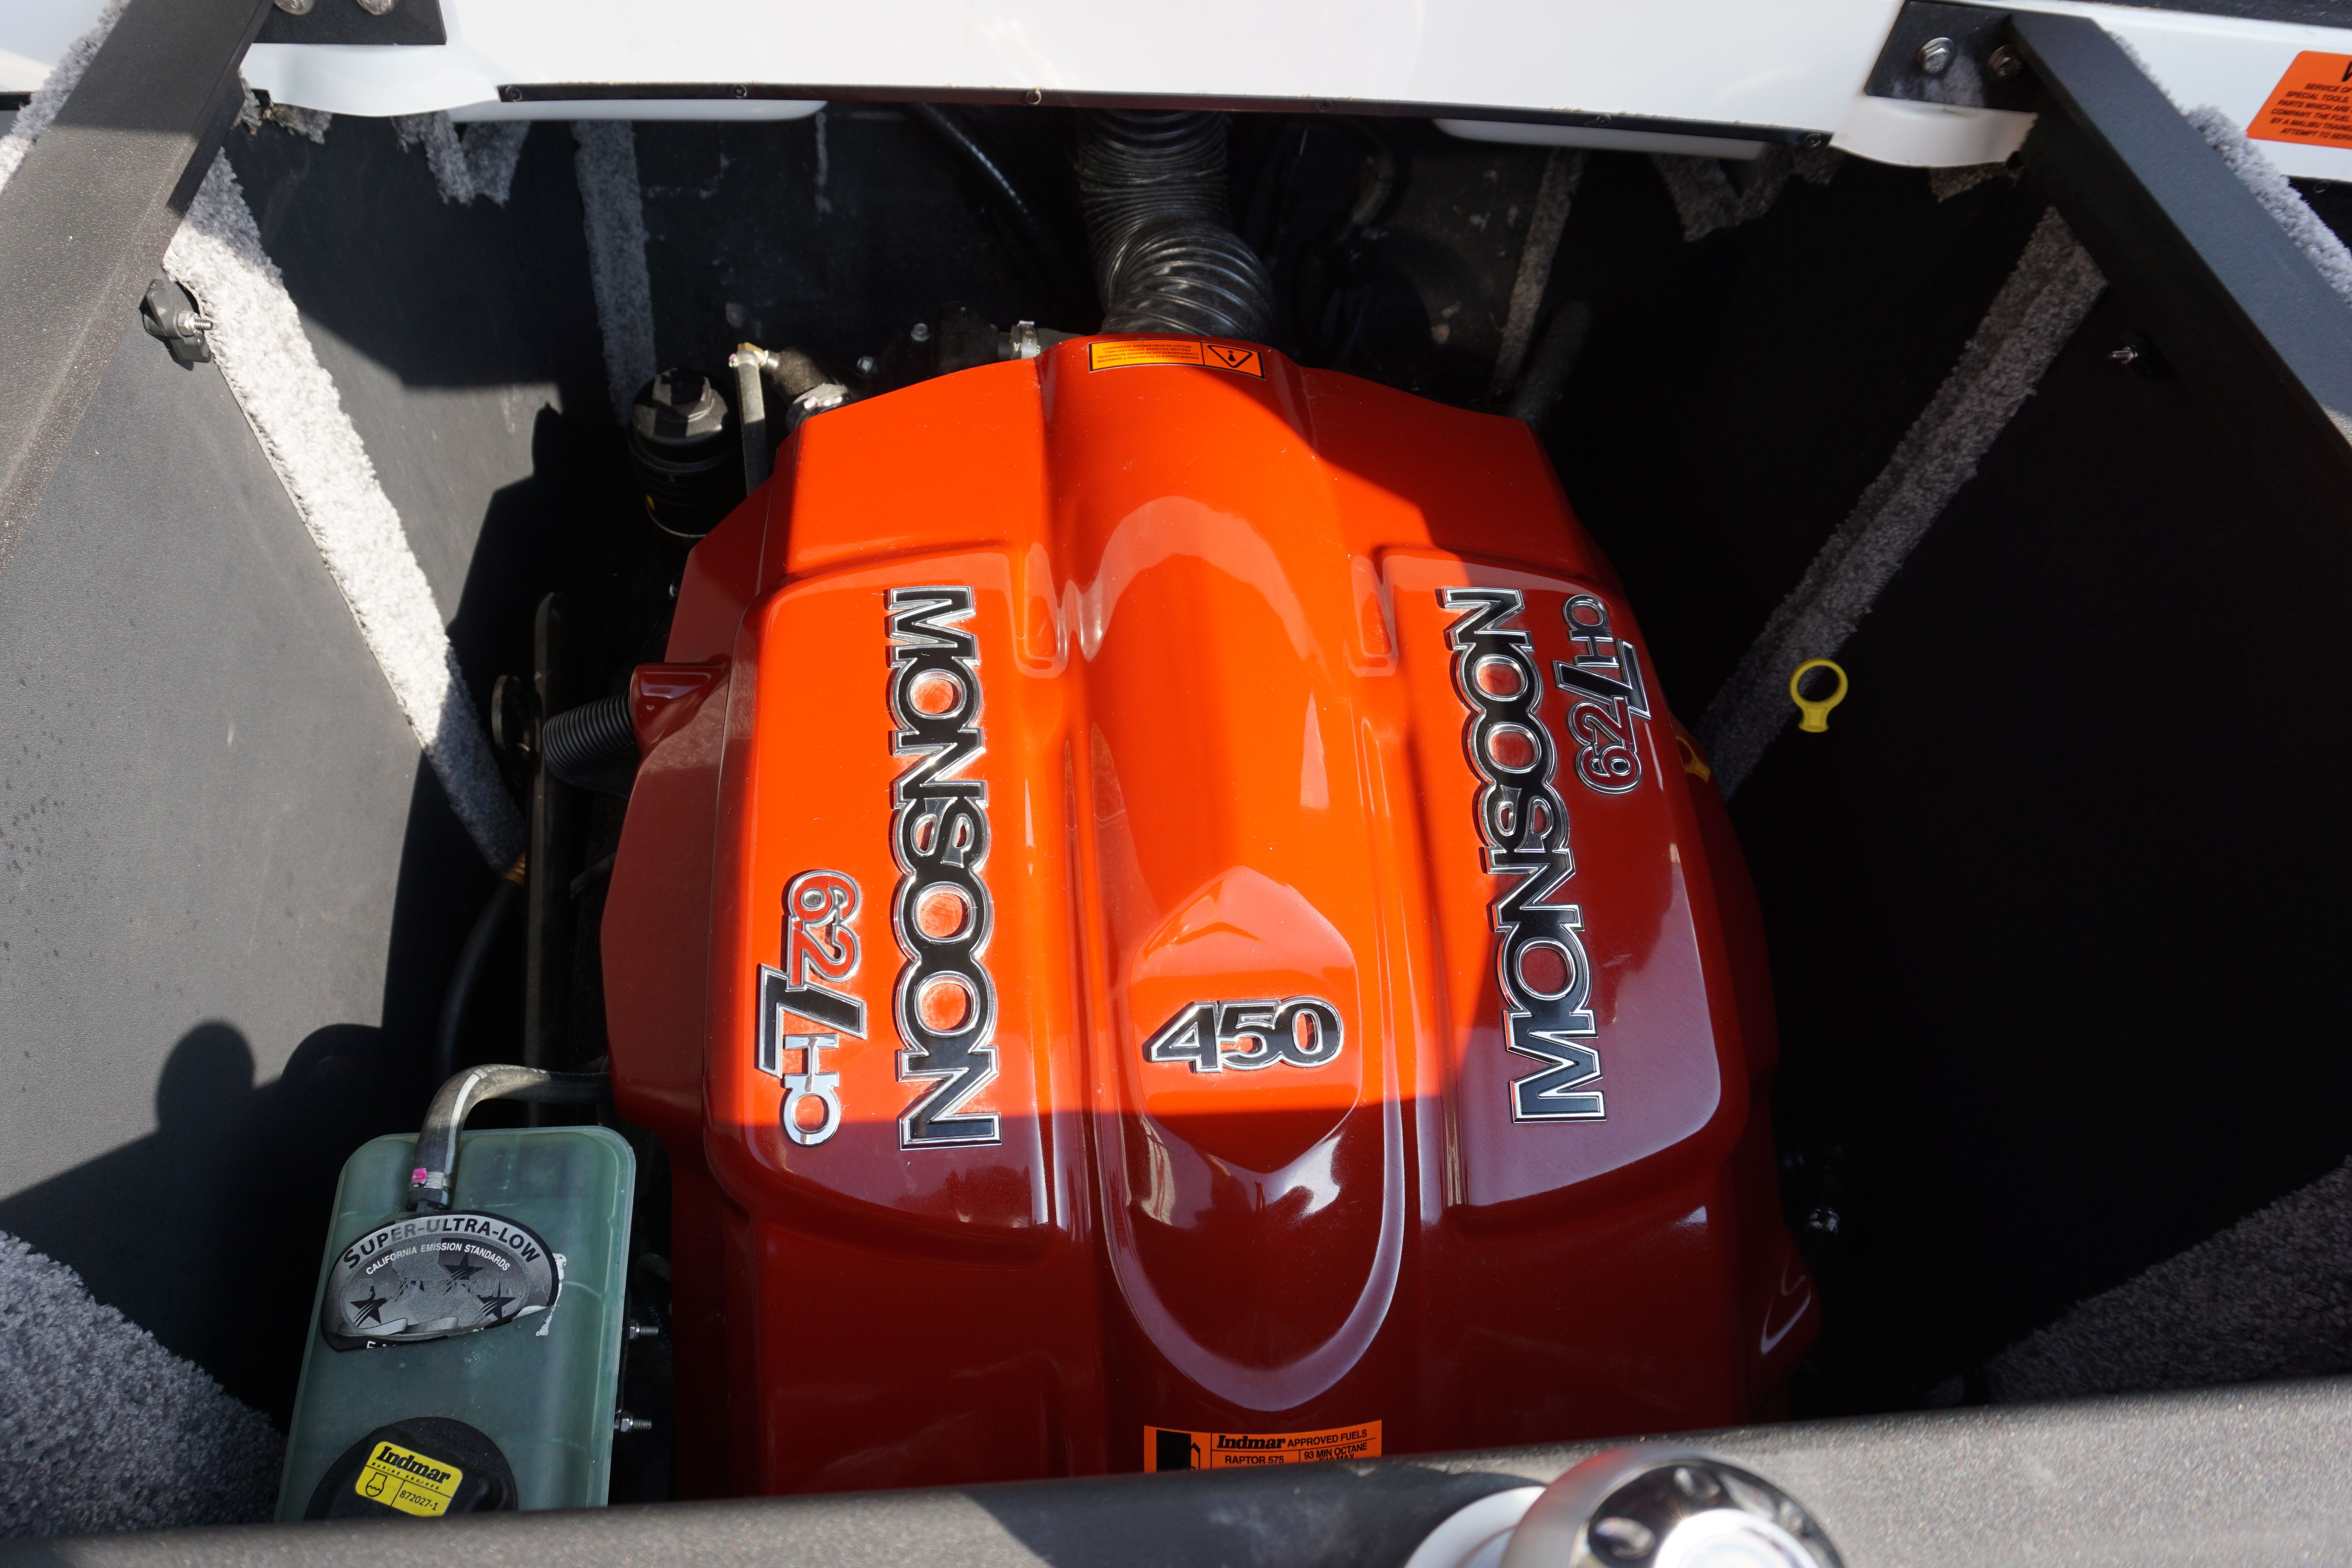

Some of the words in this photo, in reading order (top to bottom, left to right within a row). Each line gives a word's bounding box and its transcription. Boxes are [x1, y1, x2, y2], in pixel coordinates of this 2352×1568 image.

[2286, 91, 2319, 100] SPECIAL
[2321, 94, 2349, 103] TOOLS
[2305, 83, 2341, 92] SERVICE
[2279, 128, 2318, 136] ATTEMPT
[2290, 120, 2321, 128] MALIBU
[1442, 587, 1607, 1123] MONSOON
[887, 585, 1002, 1150] MONSOON
[1149, 995, 1345, 1073] 450
[366, 1247, 417, 1275] CALIFORNIA
[420, 1242, 461, 1253] EMISSION
[464, 1244, 510, 1271] STANDARDS
[1217, 1435, 1286, 1449] Indmar
[1287, 1434, 1338, 1447] APPROVED
[1341, 1429, 1367, 1442] FUELS
[1225, 1455, 1265, 1464] RAPTOR
[1269, 1455, 1284, 1464] 575
[1304, 1451, 1314, 1459] 93
[1316, 1448, 1332, 1458] MIN
[1334, 1442, 1368, 1456] OCTANE
[376, 1446, 451, 1484] Indmar
[372, 1462, 400, 1475] MARINE
[406, 1475, 439, 1490] ENGINES
[399, 1490, 439, 1511] 872027-1
